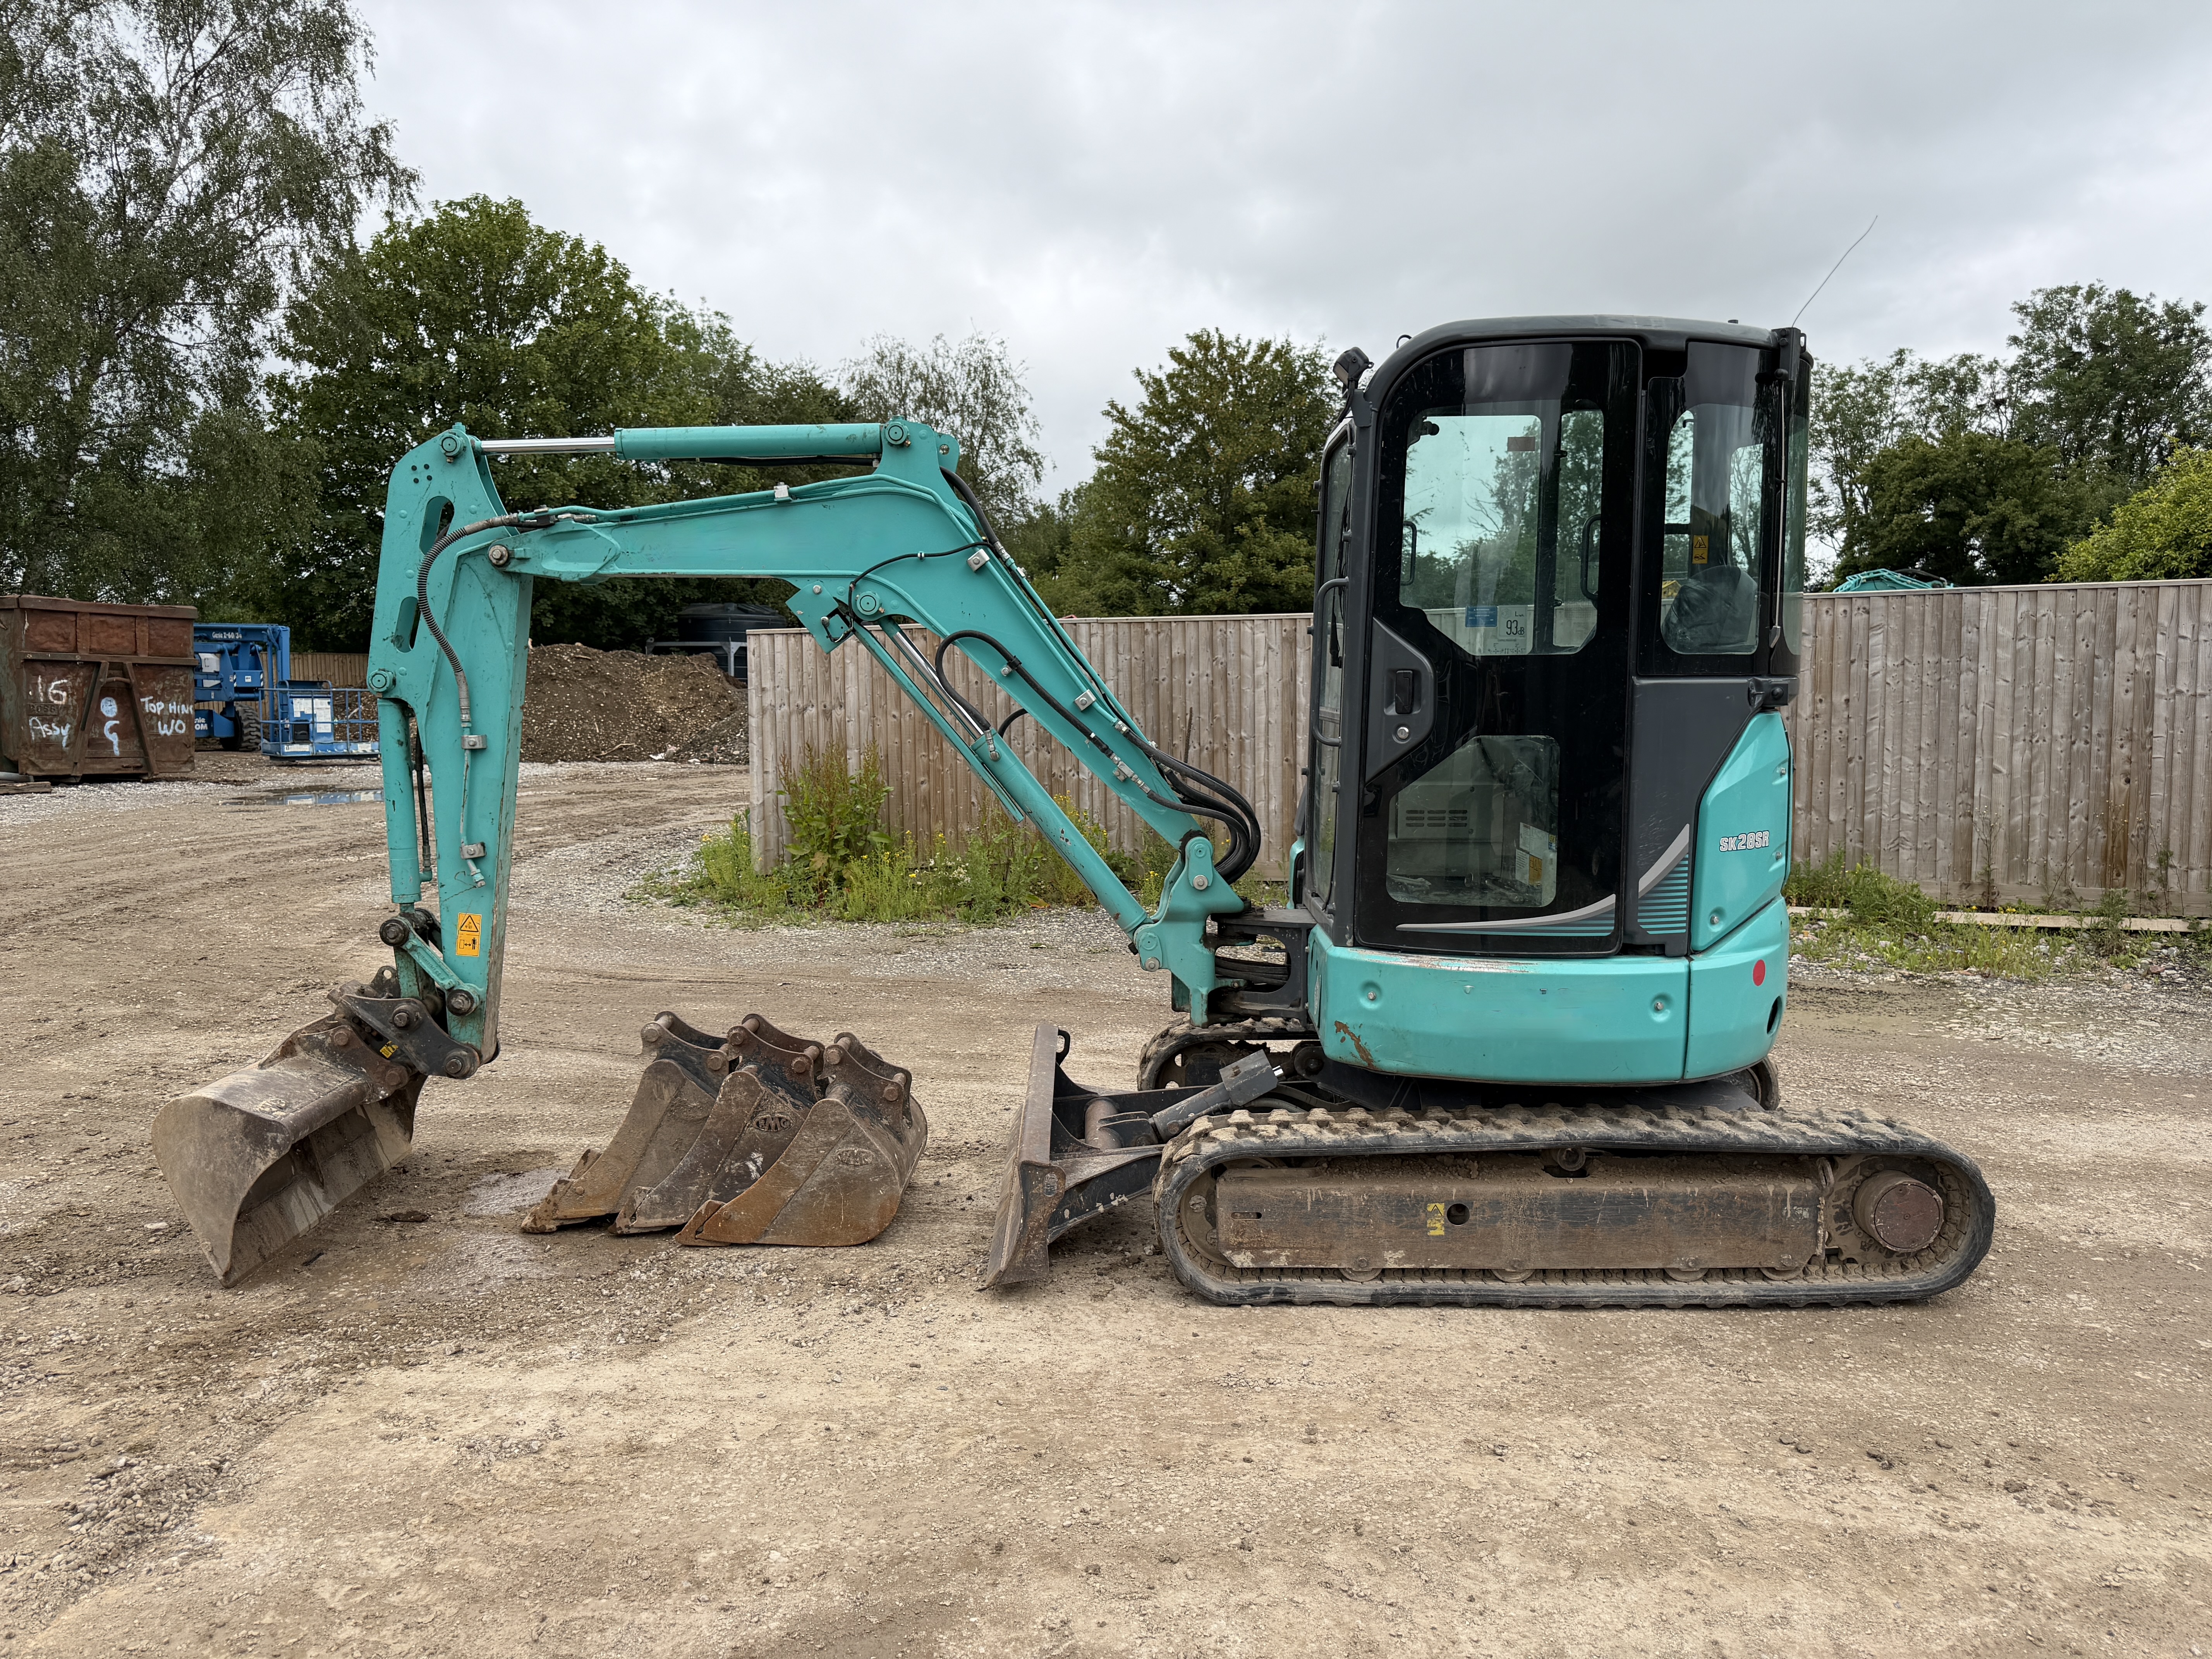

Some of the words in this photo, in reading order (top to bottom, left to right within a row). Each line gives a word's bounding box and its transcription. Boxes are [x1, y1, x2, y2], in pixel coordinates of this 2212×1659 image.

[1506, 620, 1518, 635] 93
[1518, 627, 1525, 635] dB
[1719, 830, 1769, 852] SK28SR
